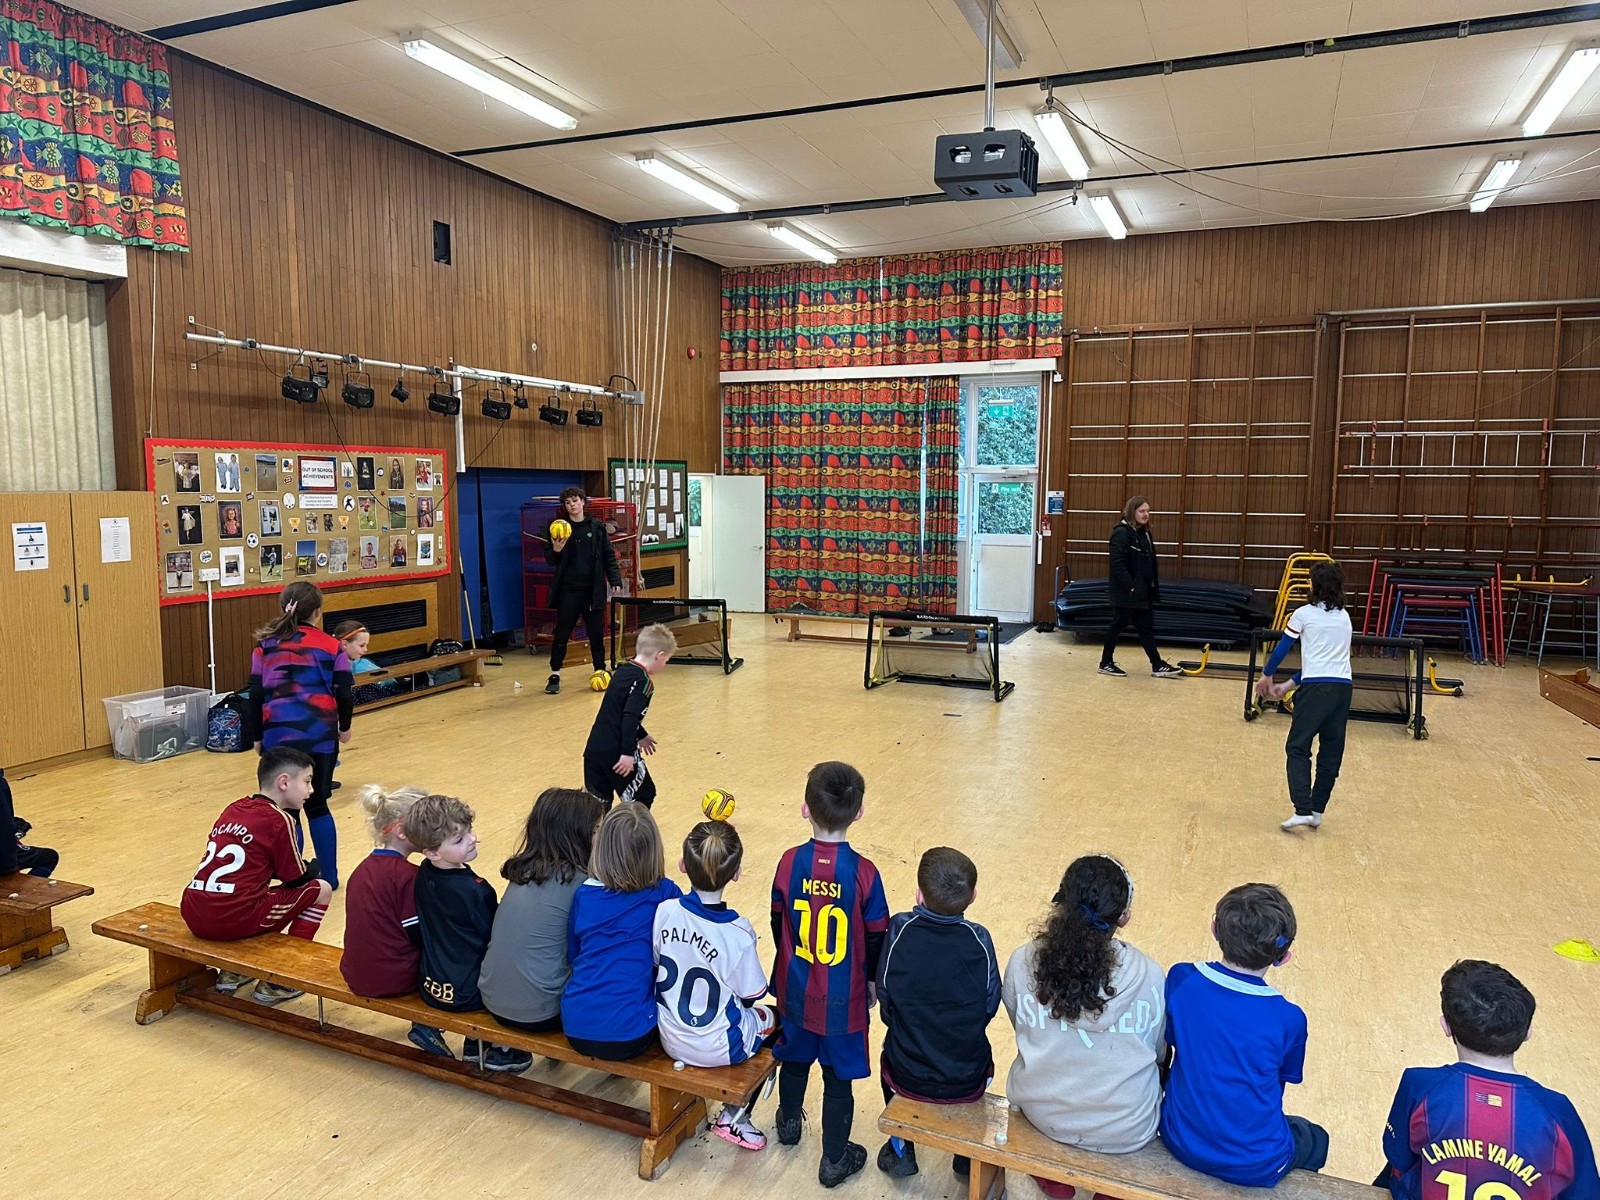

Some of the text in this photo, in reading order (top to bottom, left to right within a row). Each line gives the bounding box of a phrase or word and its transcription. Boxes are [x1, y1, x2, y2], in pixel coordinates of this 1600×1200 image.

[211, 823, 253, 844] OCAMPO
[188, 841, 245, 894] 22
[802, 878, 841, 899] MESSI
[661, 927, 719, 963] PALMER
[793, 899, 849, 966] 10
[1421, 1138, 1543, 1187] LAMINE YAMAL
